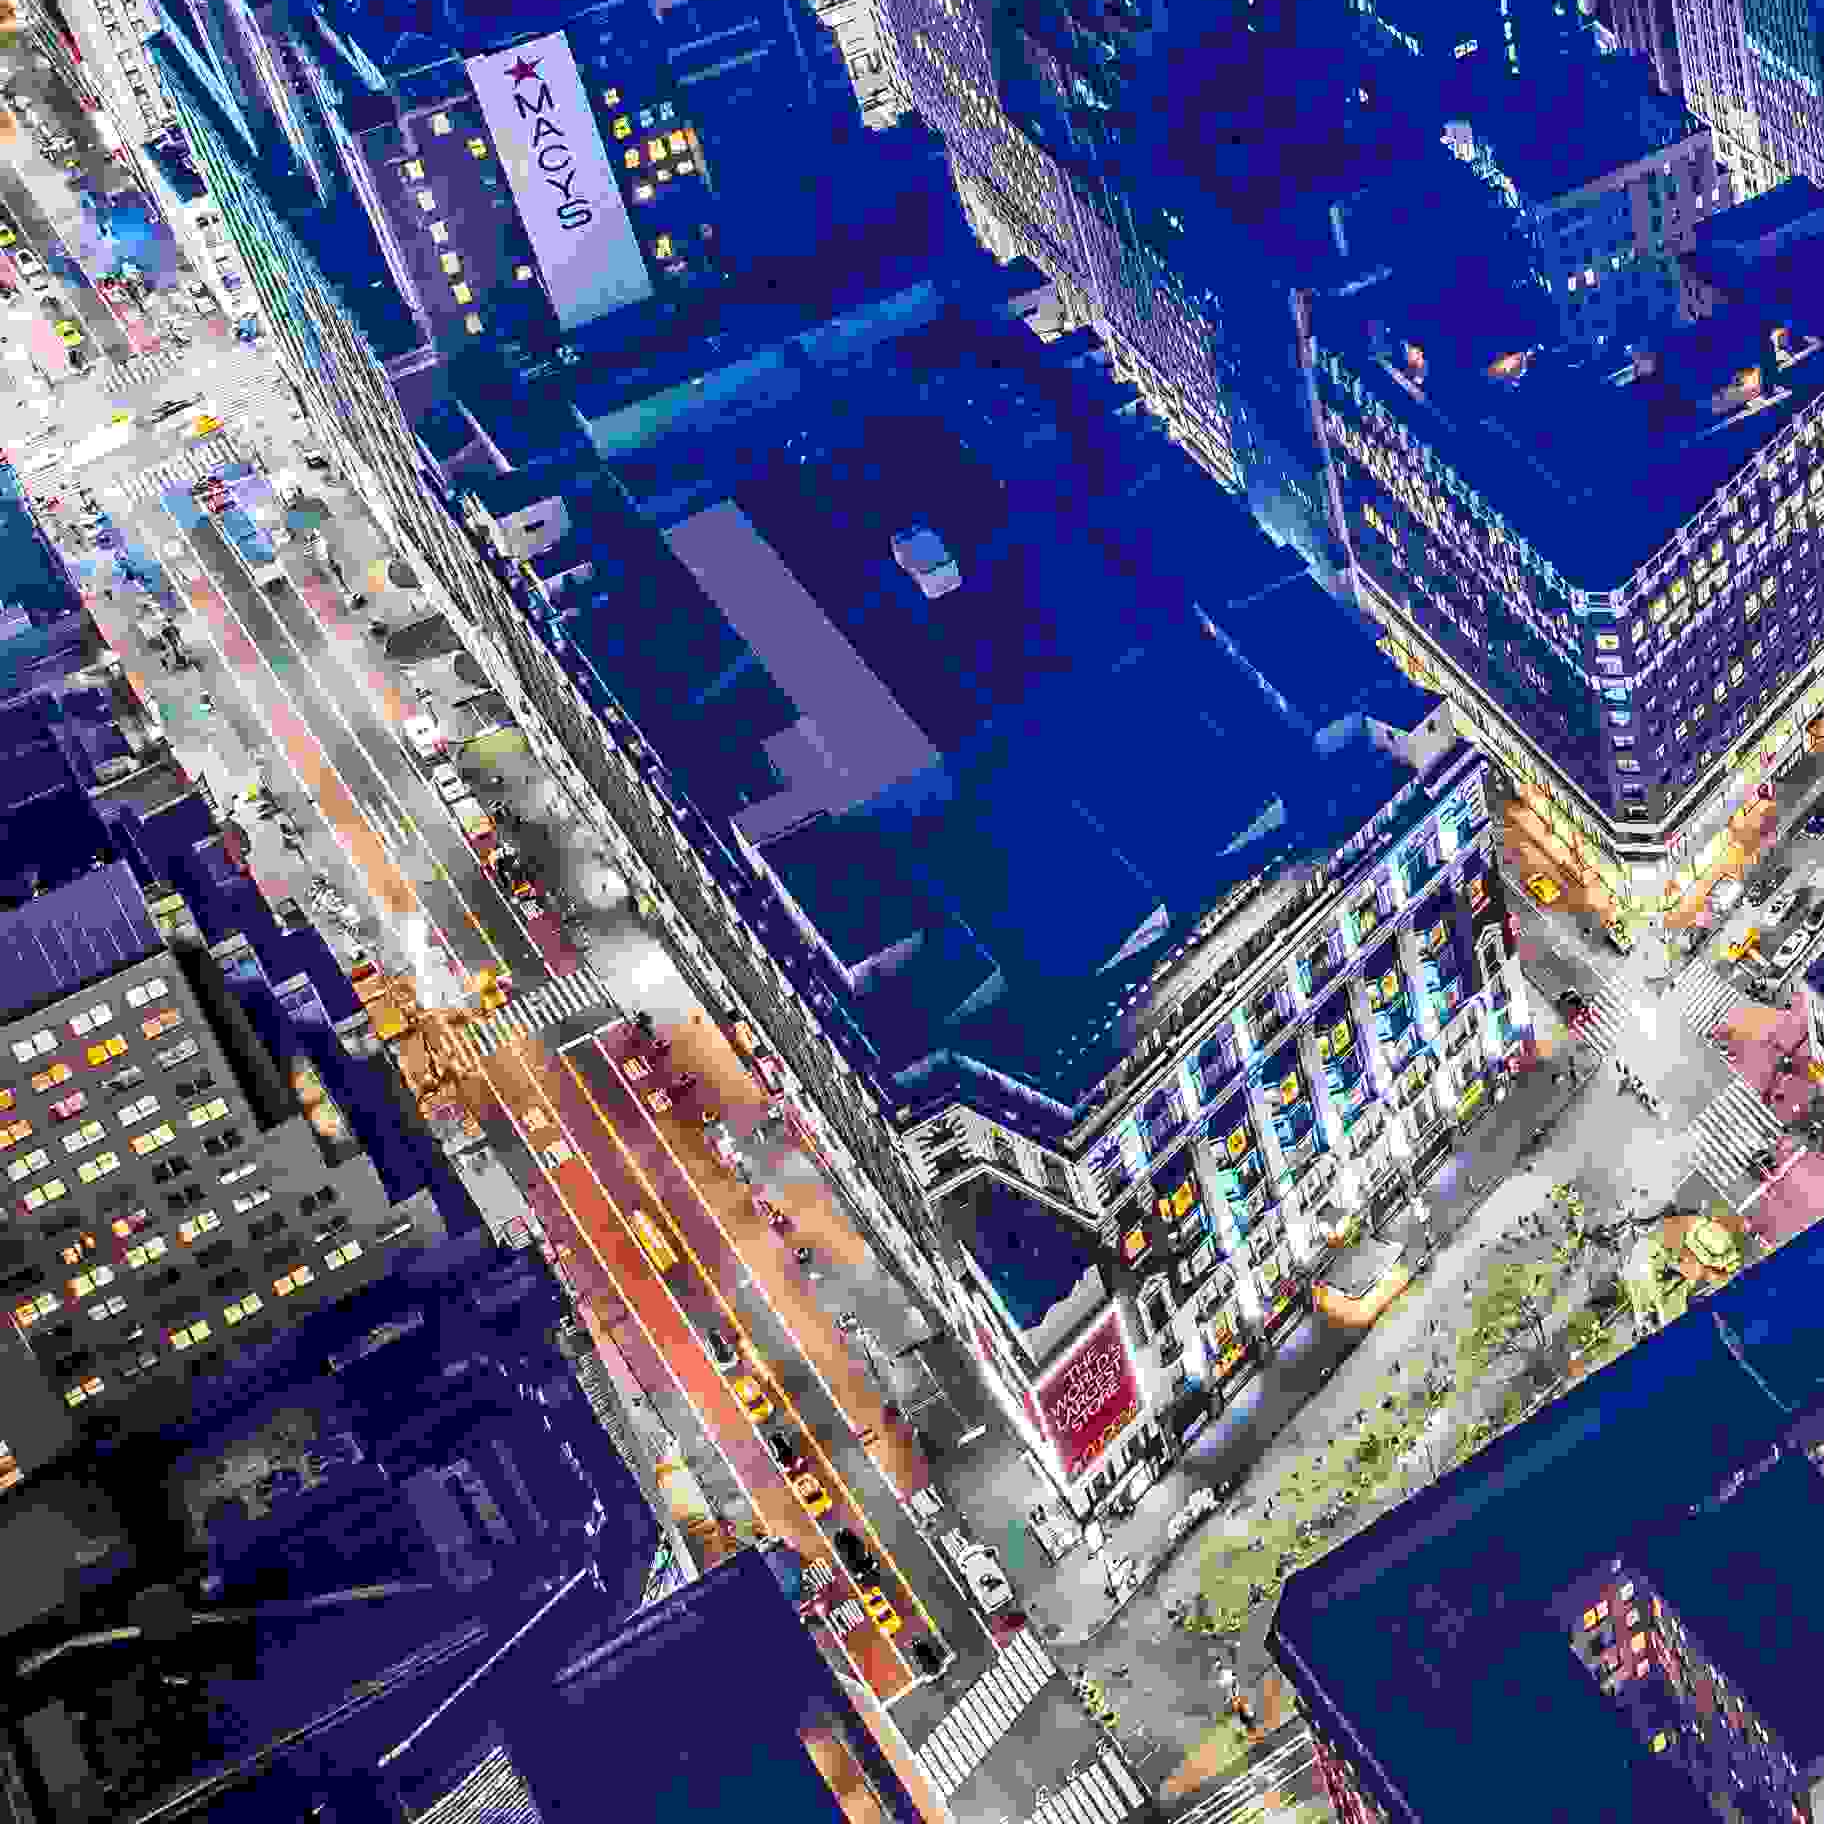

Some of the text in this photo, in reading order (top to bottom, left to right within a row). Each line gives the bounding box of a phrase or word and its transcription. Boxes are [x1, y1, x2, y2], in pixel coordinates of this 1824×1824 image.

[1064, 1344, 1098, 1382] THE
[1056, 1359, 1120, 1431] LARGEST
[1071, 1377, 1121, 1433] STORE
